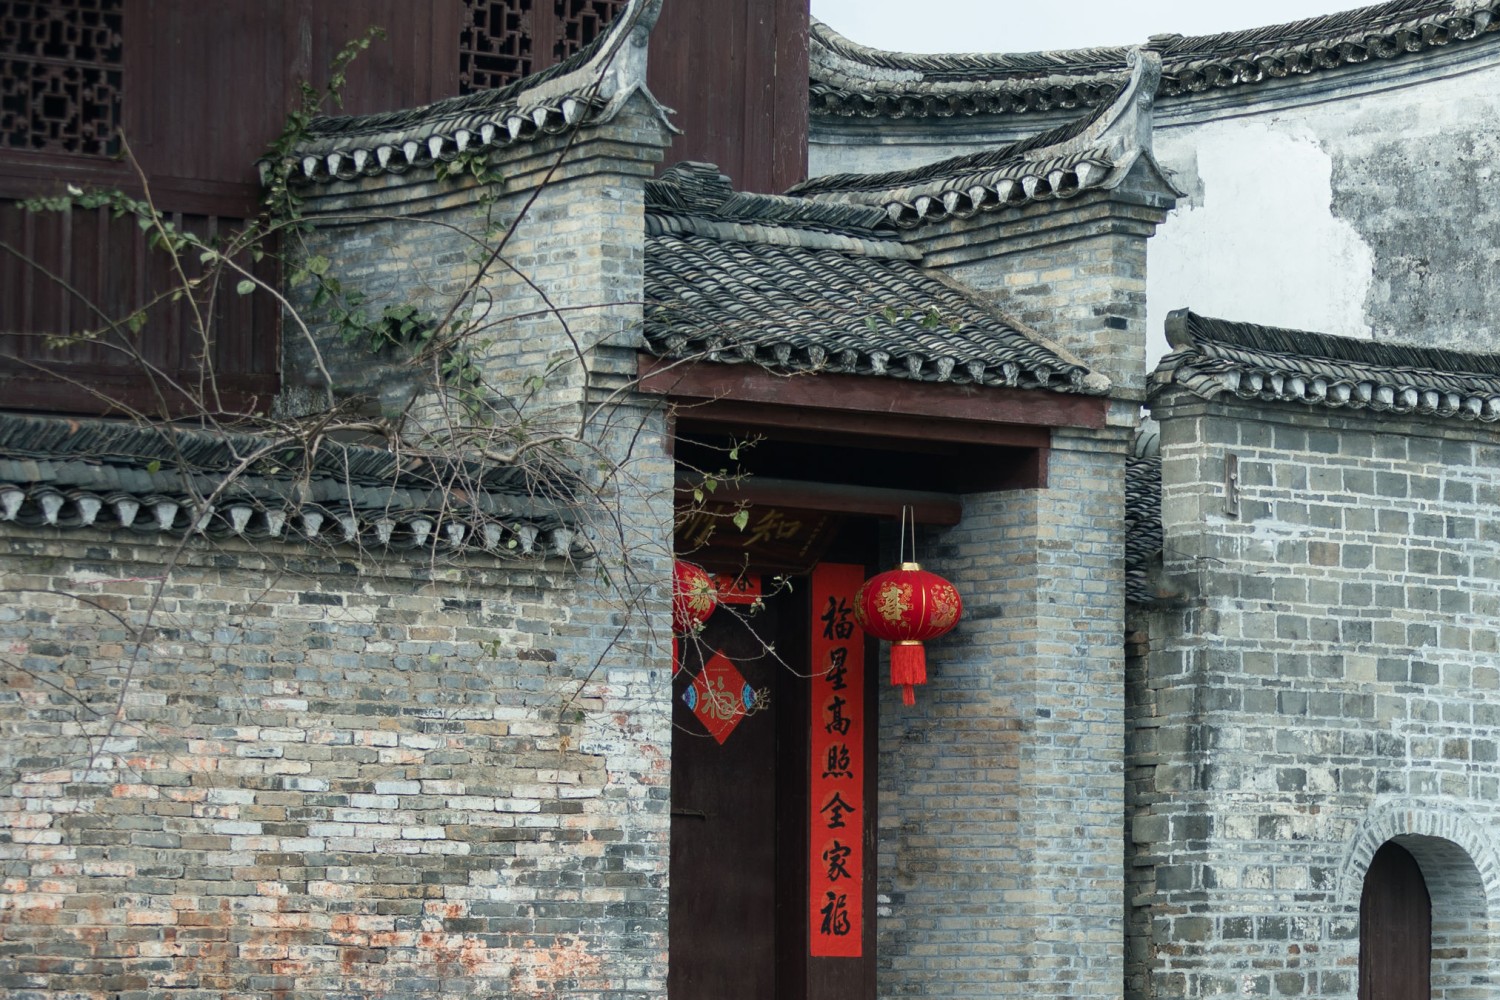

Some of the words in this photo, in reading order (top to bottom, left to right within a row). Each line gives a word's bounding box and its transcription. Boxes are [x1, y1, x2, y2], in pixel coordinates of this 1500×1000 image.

[701, 675, 739, 720] 福
[820, 597, 857, 936] 福星高照全家福
